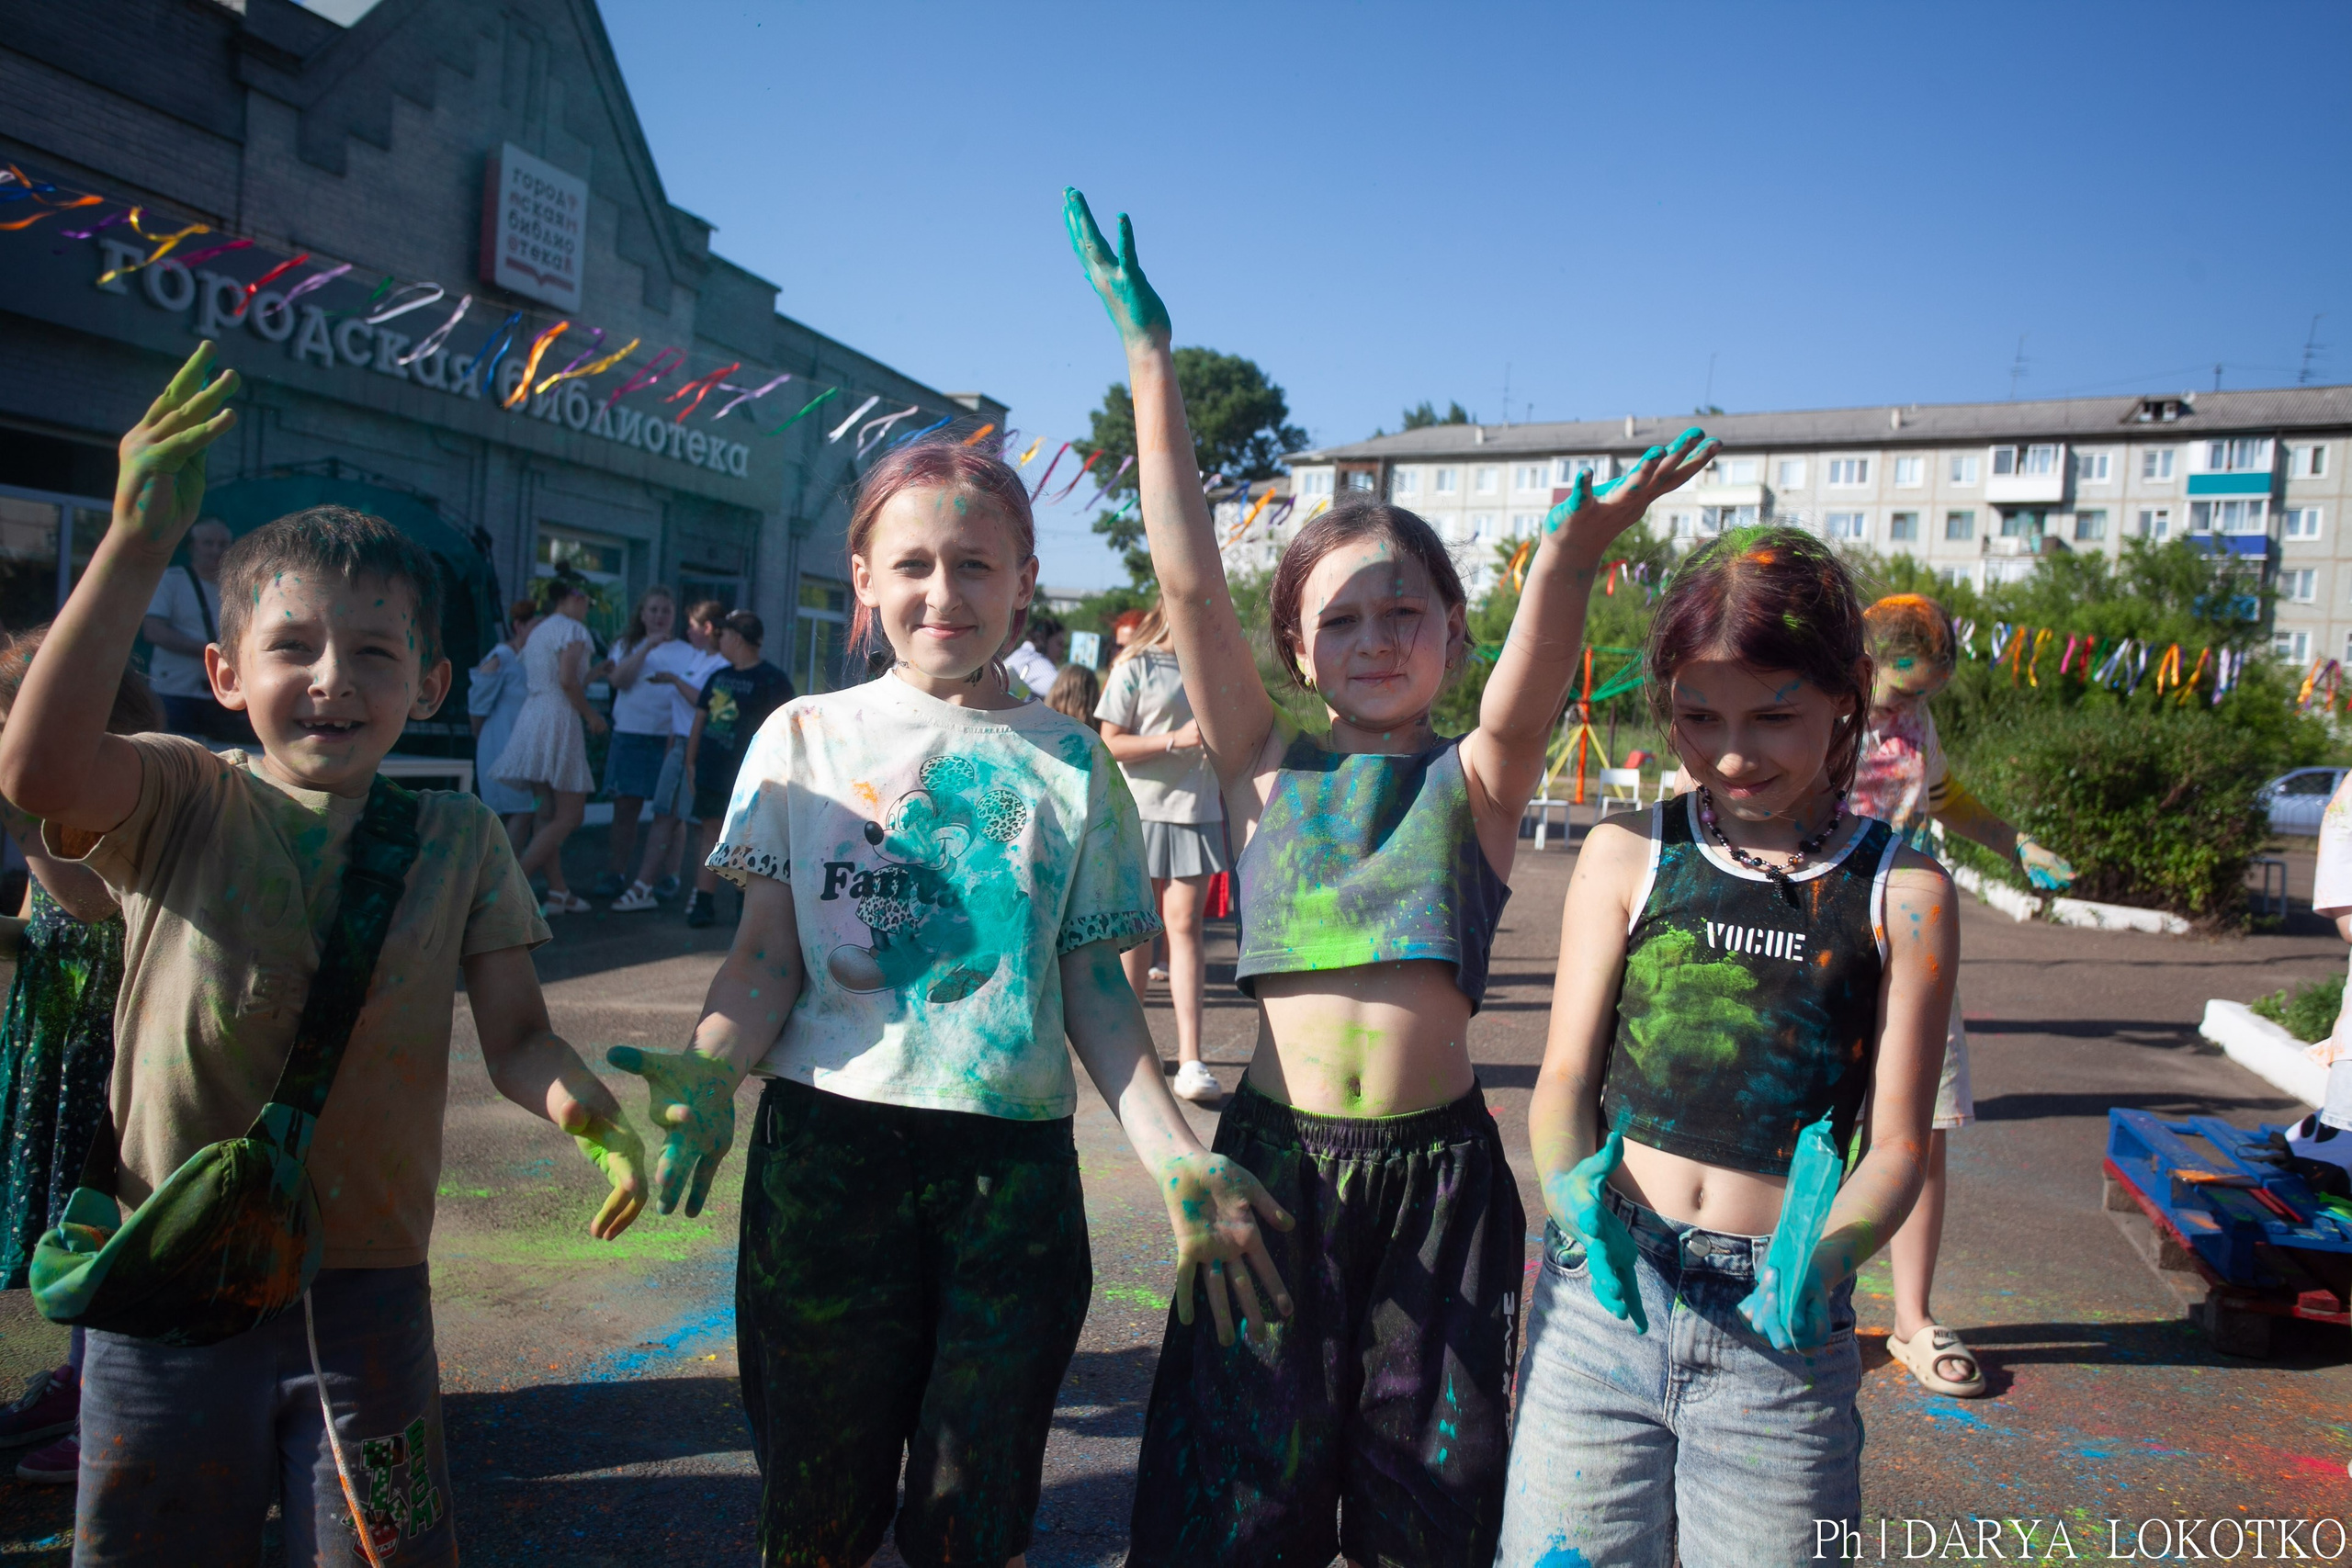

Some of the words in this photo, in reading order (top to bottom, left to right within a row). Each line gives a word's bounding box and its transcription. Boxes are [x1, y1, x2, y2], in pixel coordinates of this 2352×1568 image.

[98, 238, 481, 400] городская
[496, 357, 750, 478] библиотека
[1706, 921, 1806, 962] VOGUE
